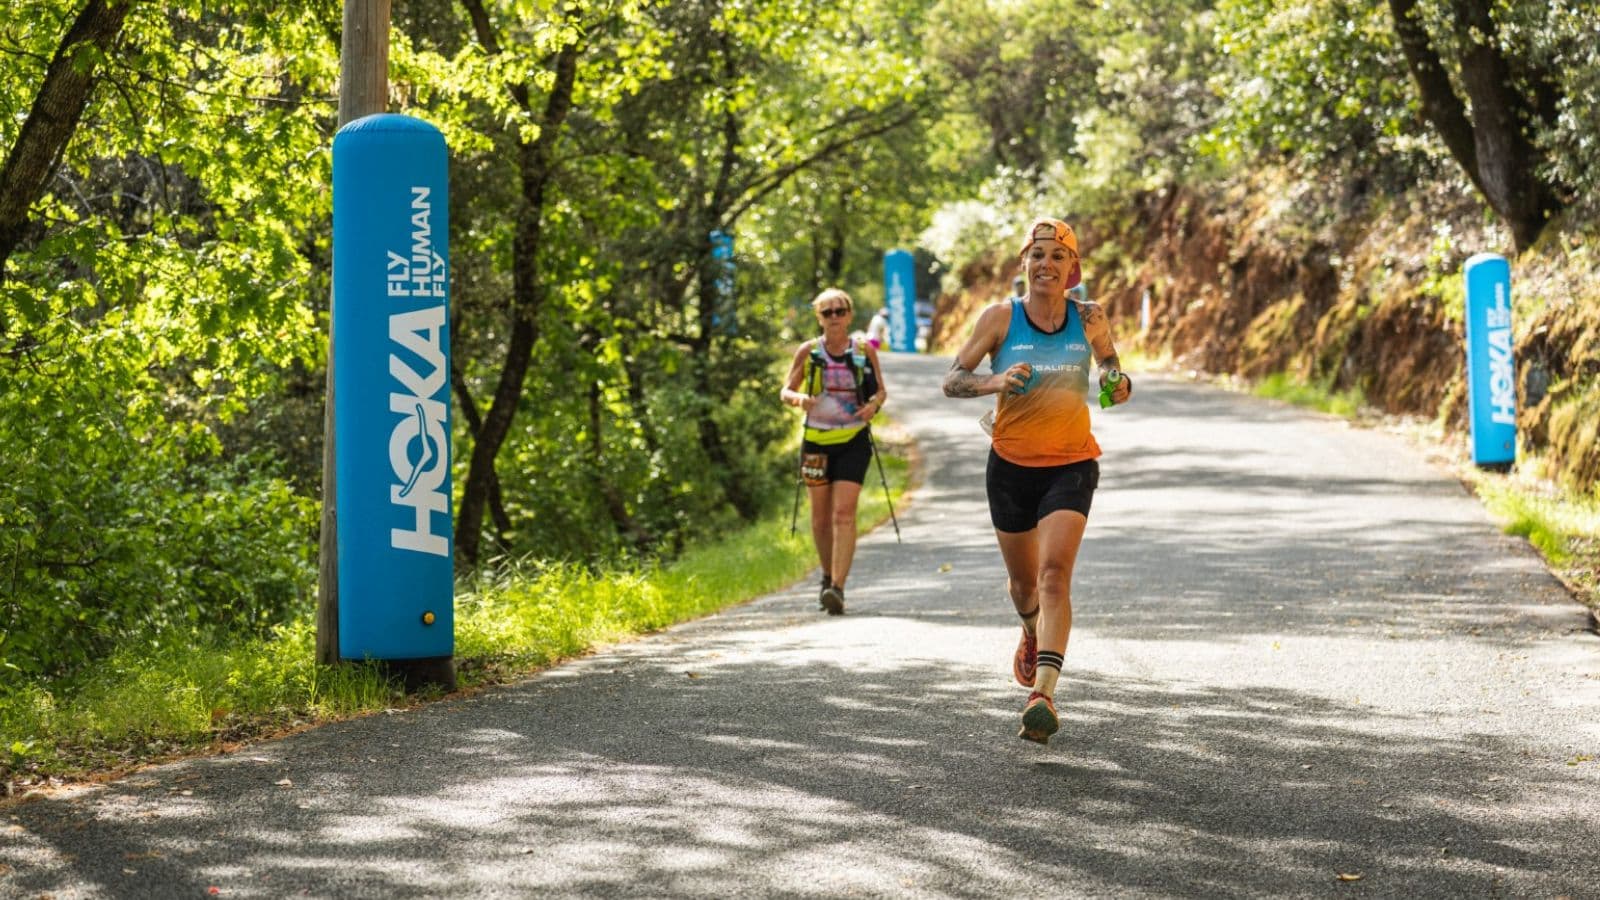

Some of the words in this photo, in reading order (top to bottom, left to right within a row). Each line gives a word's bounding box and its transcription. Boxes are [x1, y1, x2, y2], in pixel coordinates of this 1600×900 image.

[387, 249, 410, 297] FLY
[411, 186, 431, 297] HUMAN
[432, 250, 446, 297] FLY
[1487, 327, 1515, 425] HOKA
[388, 304, 449, 558] HOKA
